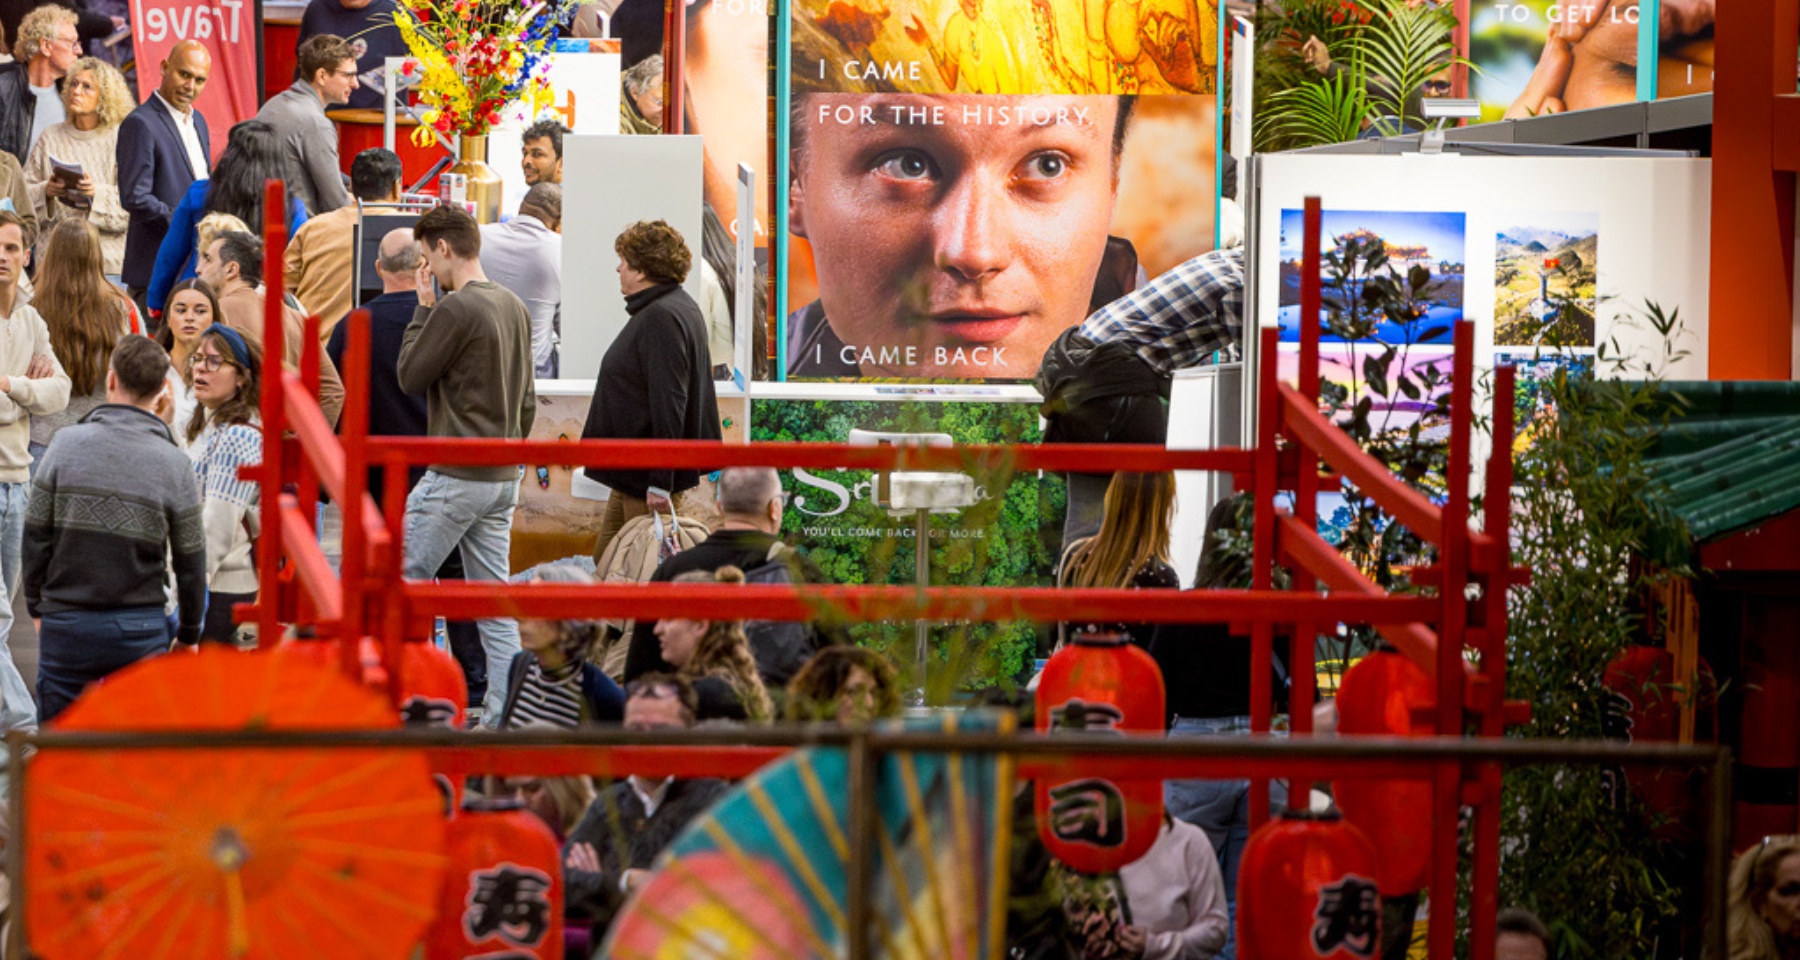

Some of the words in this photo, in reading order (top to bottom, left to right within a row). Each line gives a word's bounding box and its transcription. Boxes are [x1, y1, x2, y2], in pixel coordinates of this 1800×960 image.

[712, 0, 765, 15] FOR
[1494, 4, 1530, 22] TO
[1546, 5, 1595, 23] GET
[820, 58, 825, 79] I
[843, 60, 920, 80] CAME
[819, 104, 876, 125] FOR
[890, 106, 944, 125] THE
[816, 343, 822, 364] I
[840, 346, 917, 366] CAME
[934, 347, 1008, 366] BACK
[802, 527, 843, 538] YOU'LL
[847, 527, 881, 538] COME
[928, 529, 946, 539] OR
[949, 529, 985, 539] MORE
